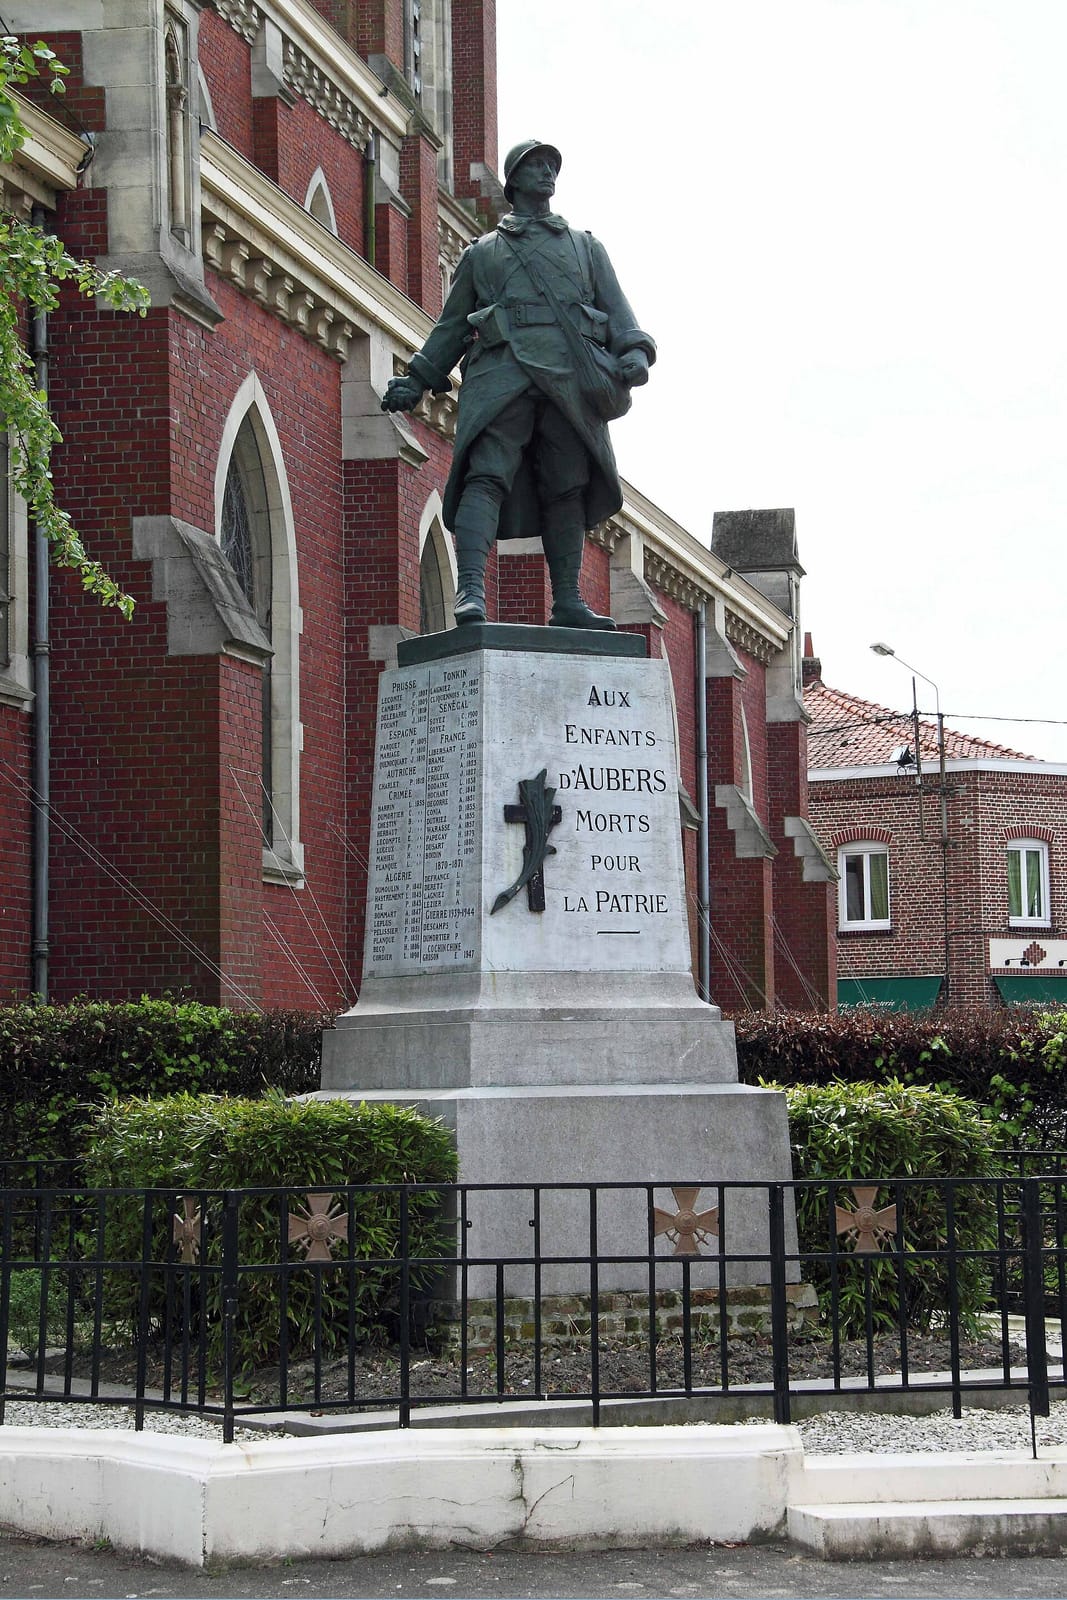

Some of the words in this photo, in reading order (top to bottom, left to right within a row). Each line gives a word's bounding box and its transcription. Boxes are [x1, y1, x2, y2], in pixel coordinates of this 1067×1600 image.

[443, 669, 467, 682] TONKIN
[392, 680, 416, 692] PRUSSE
[586, 685, 632, 708] AUX
[390, 728, 417, 740] ESPAGNE
[440, 732, 466, 744] FRANCE
[565, 724, 656, 747] ENFANTS
[428, 756, 444, 765] BRAME
[386, 766, 416, 779] AUTRICHE
[428, 764, 443, 774] LEROY
[388, 787, 412, 800] CRIMÉE
[576, 810, 650, 833] MORTS
[591, 855, 642, 873] POUR
[564, 896, 589, 913] LA
[595, 890, 668, 914] PATRIE
[426, 909, 448, 920] GUERRE
[424, 922, 449, 931] DESCAMPS
[464, 950, 475, 959] 1947
